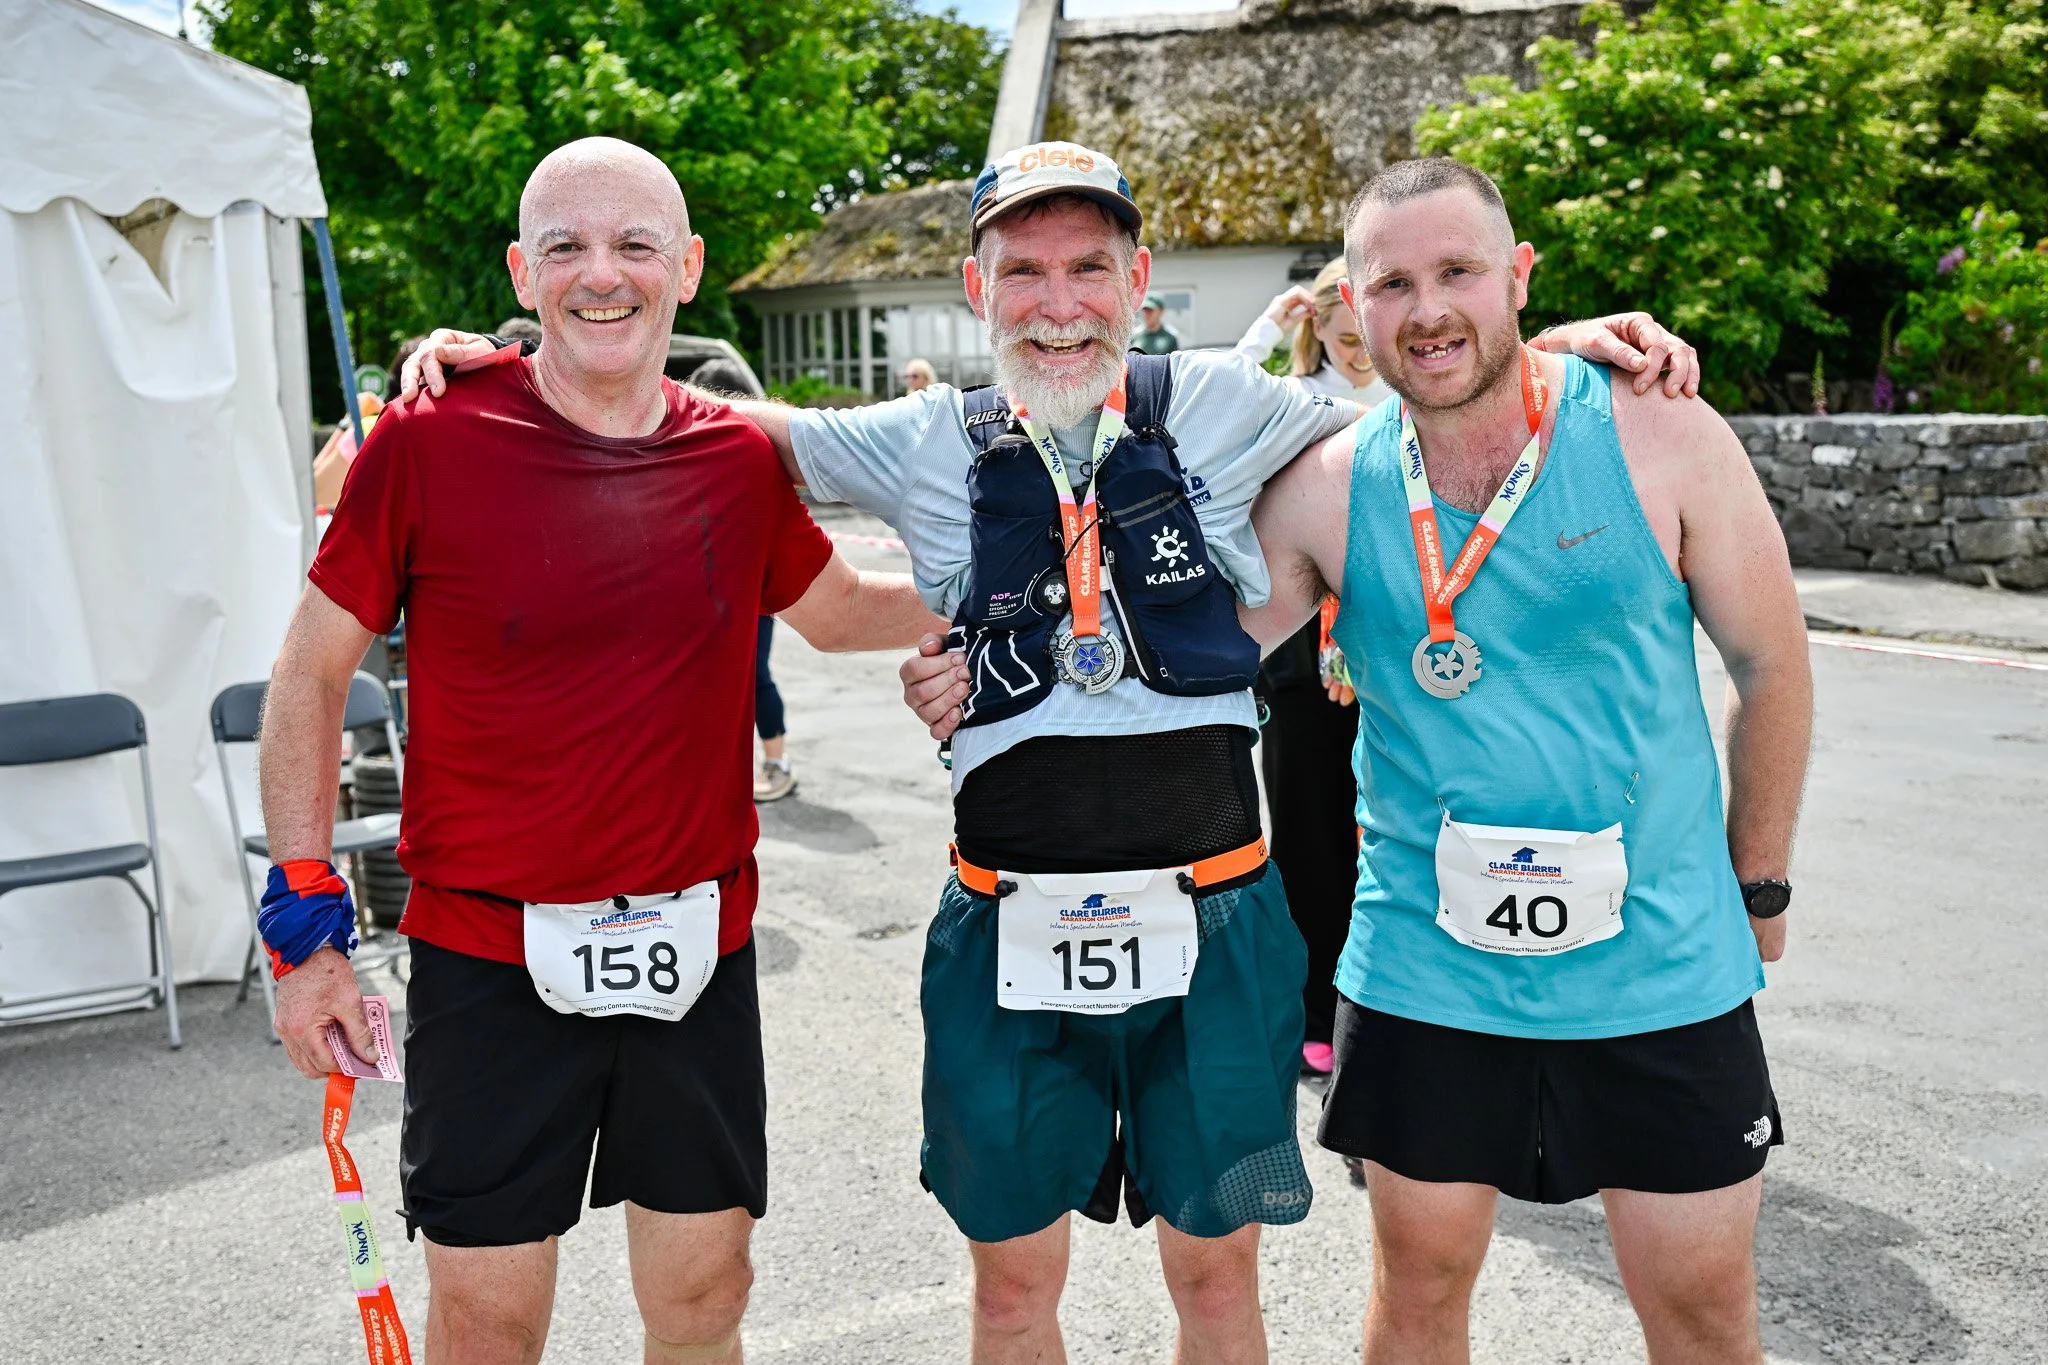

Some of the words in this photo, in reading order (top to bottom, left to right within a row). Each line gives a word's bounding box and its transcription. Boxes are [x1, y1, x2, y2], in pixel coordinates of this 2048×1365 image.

[1039, 436, 1063, 474] MONKS
[1093, 435, 1115, 472] MONK
[1406, 437, 1423, 480] MONKS
[1500, 461, 1530, 502] MONKS
[1422, 520, 1437, 555] CLARE
[1145, 563, 1206, 585] KAILAS
[1437, 575, 1461, 604] CLARE
[1456, 534, 1485, 576] BURREN
[990, 592, 1011, 601] ADF
[1488, 861, 1519, 871] CLARE
[1520, 864, 1562, 873] BURREN
[1488, 868, 1525, 876] MARATHON
[590, 914, 621, 927] CLARE
[622, 910, 662, 922] BURREN
[1059, 909, 1090, 918] CLARE
[1091, 905, 1131, 917] BURREN
[1096, 913, 1132, 921] CHALLENGE
[1485, 894, 1568, 938] 40
[591, 921, 627, 930] MARATHON
[627, 916, 663, 926] CHALLENGE
[1471, 939, 1501, 950] Emergency
[572, 941, 680, 995] 158
[1052, 936, 1142, 991] 151
[1040, 1001, 1072, 1009] Emergency
[1752, 1118, 1765, 1130] THE
[1743, 1128, 1766, 1143] NORTH
[1752, 1134, 1768, 1149] FACE
[351, 1221, 369, 1265] MONKS
[369, 1307, 383, 1346] CLARE
